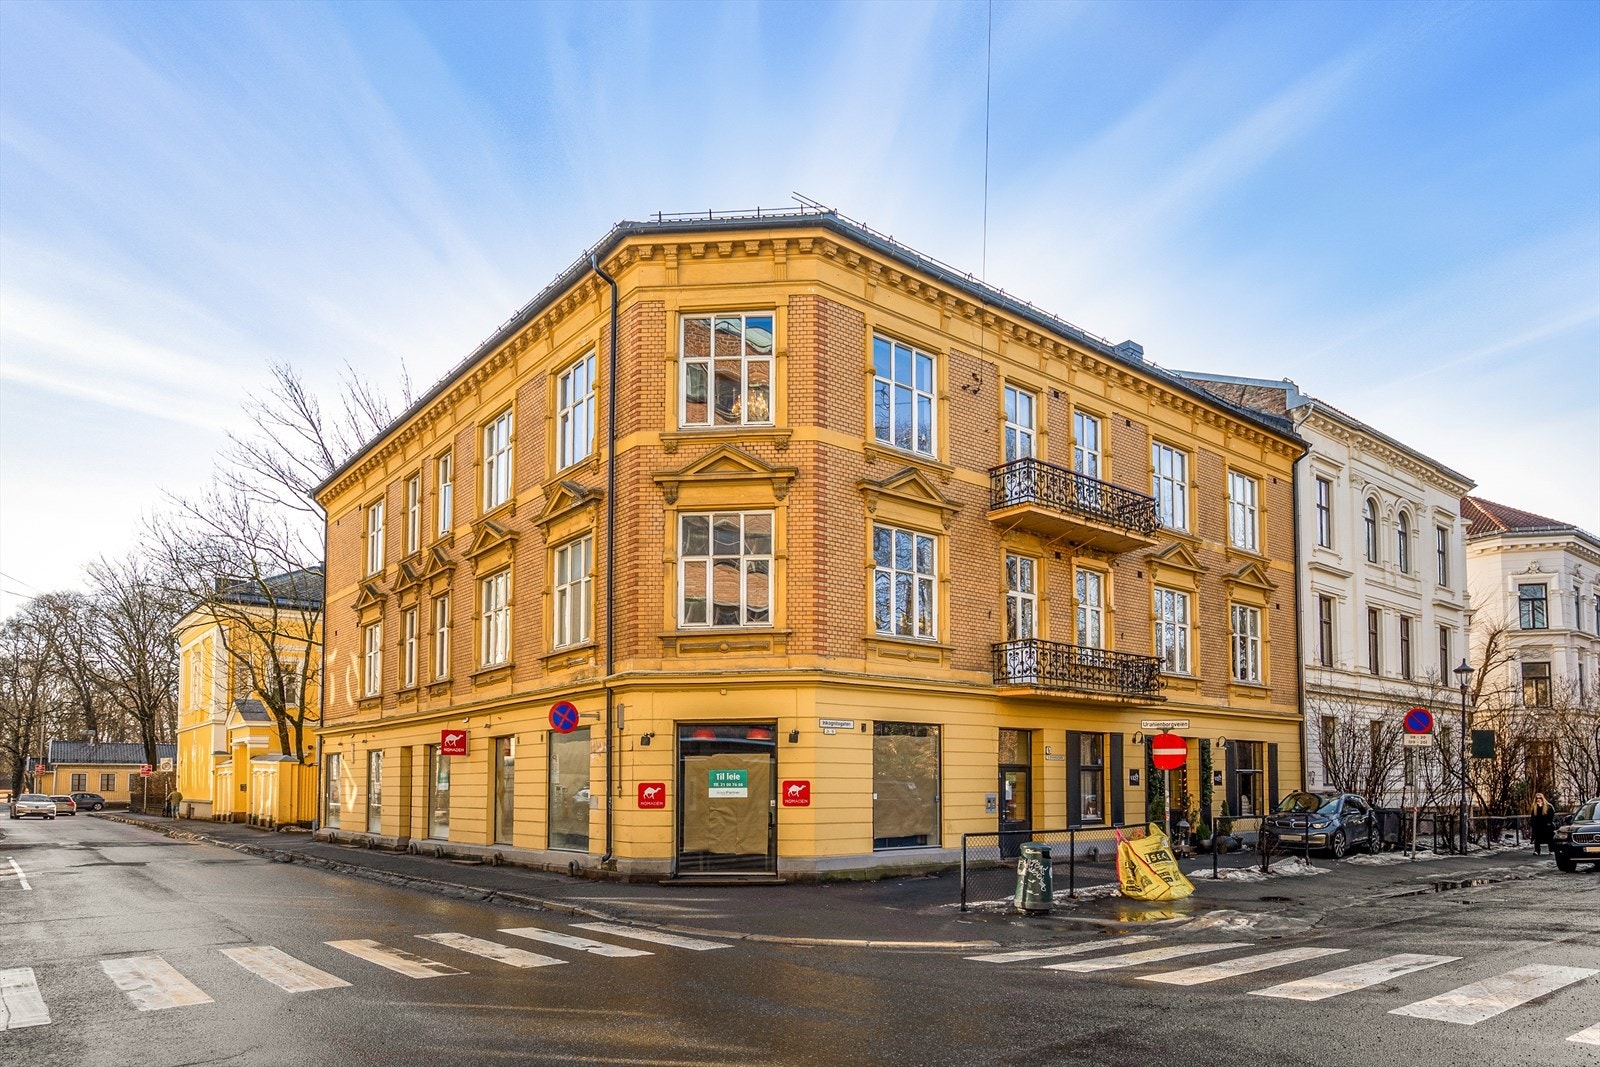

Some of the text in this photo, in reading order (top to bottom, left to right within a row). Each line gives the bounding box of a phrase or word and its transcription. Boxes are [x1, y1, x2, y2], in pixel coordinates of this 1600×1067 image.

[1142, 721, 1188, 729] Uranienborgveien
[716, 772, 741, 780] Til leie
